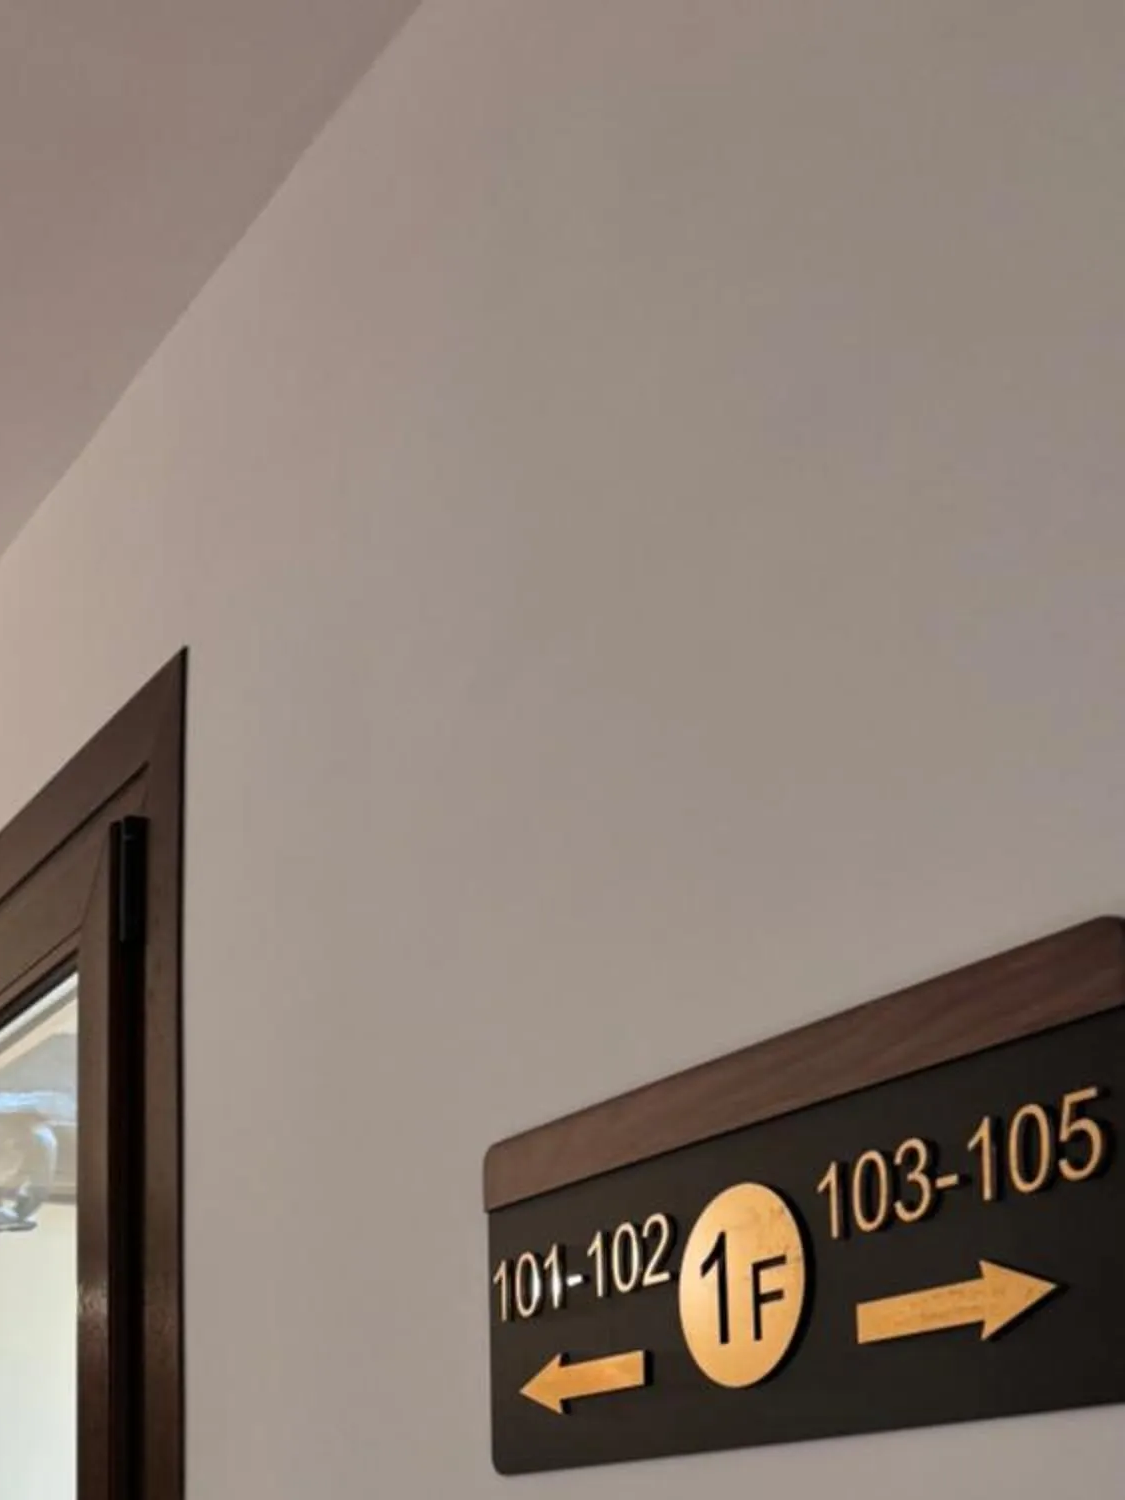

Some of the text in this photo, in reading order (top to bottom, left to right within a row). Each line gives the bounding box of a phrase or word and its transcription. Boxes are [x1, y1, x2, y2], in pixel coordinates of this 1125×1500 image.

[817, 1086, 1106, 1239] 103-105
[492, 1212, 672, 1321] 101-102
[700, 1230, 788, 1345] 1F
